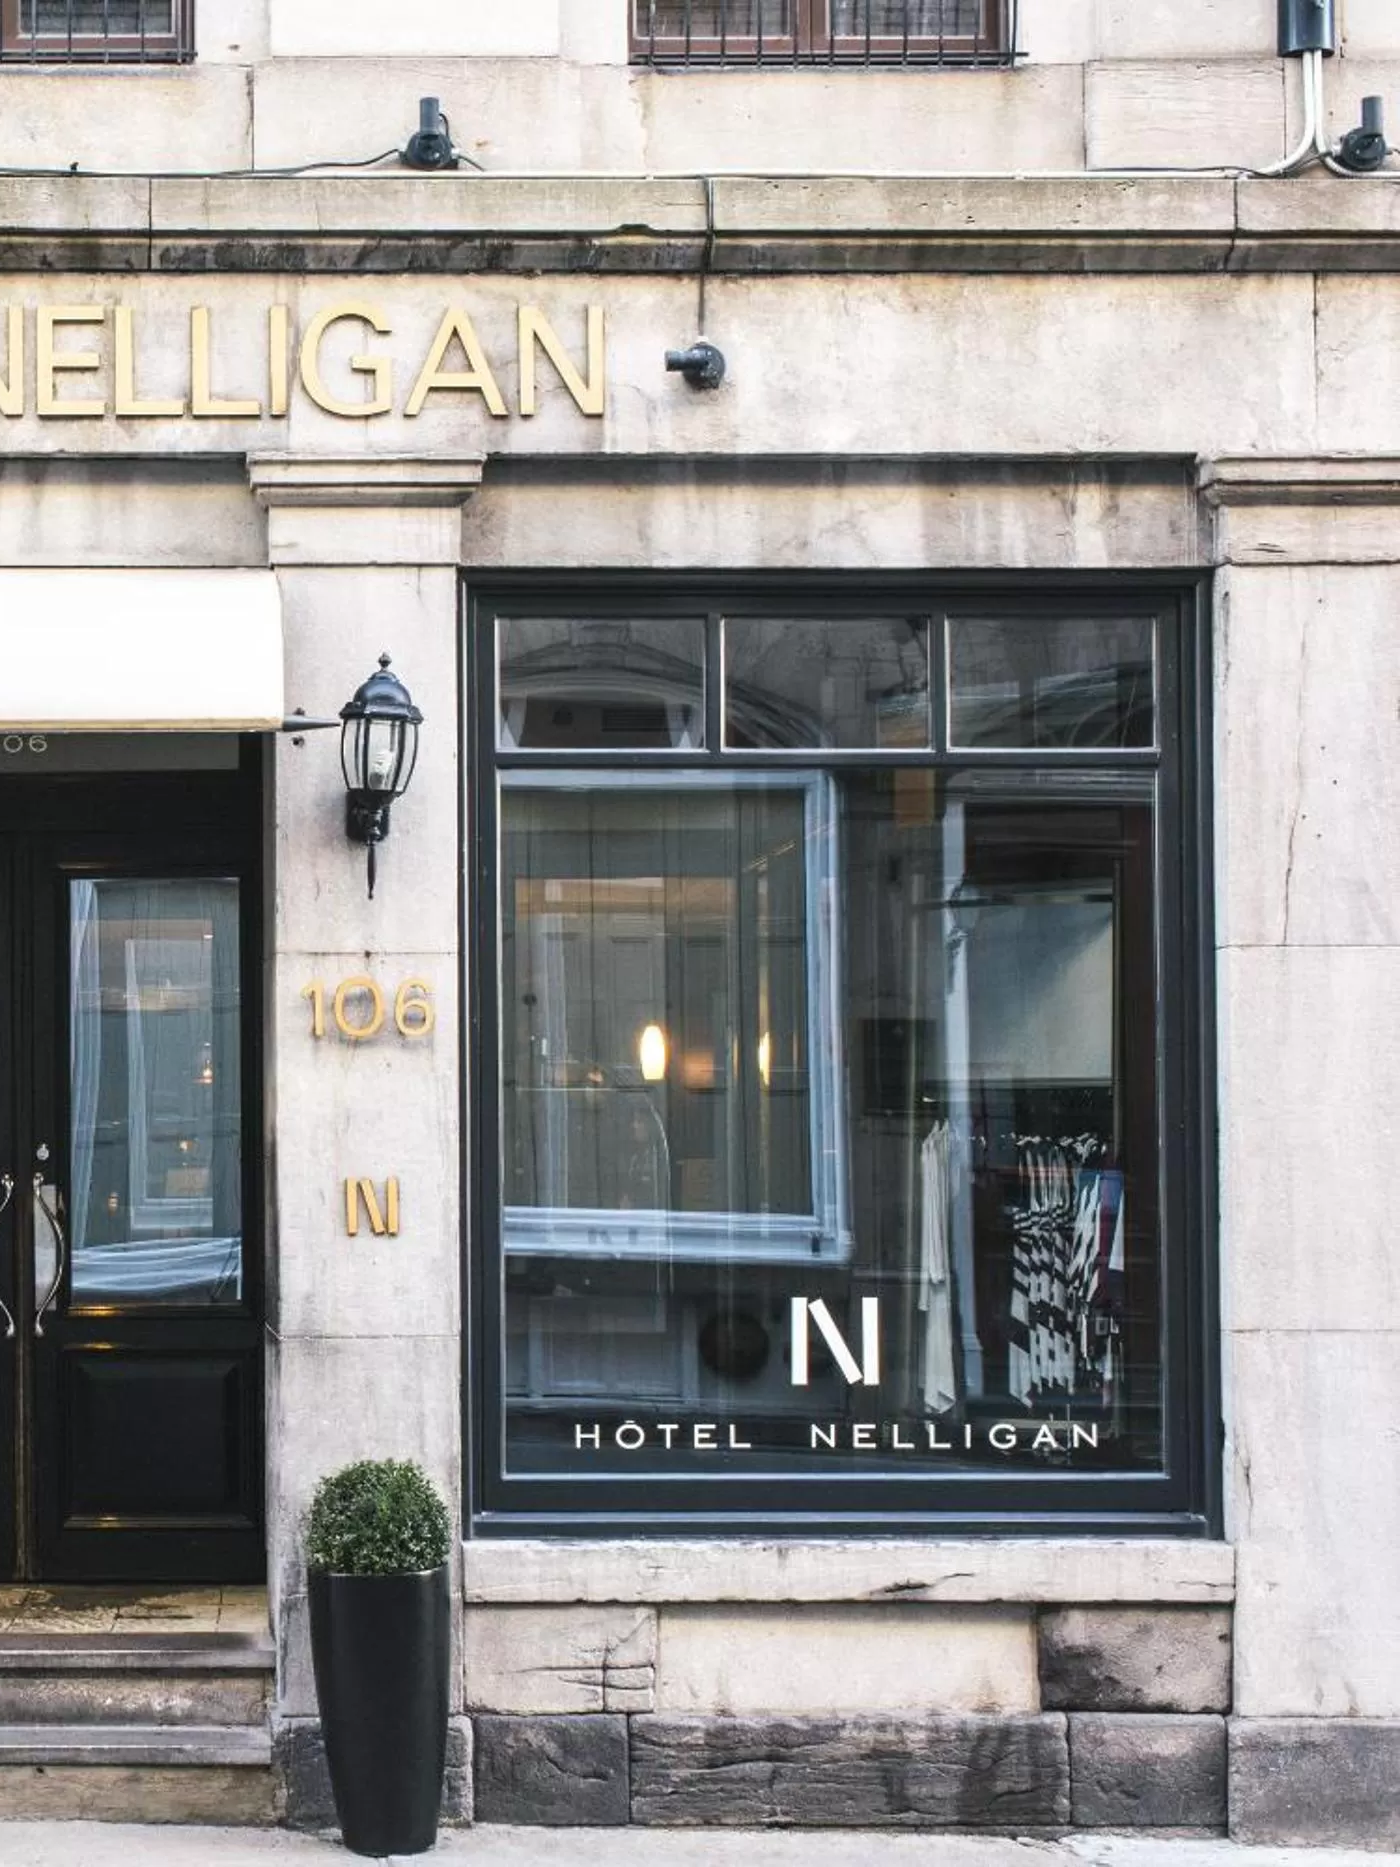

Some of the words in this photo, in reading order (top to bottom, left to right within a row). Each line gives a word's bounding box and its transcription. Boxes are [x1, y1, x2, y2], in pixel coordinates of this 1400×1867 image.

[300, 976, 435, 1037] 106
[344, 1175, 400, 1236] N
[790, 1297, 880, 1385] N
[810, 1423, 1099, 1449] NELLIGAN
